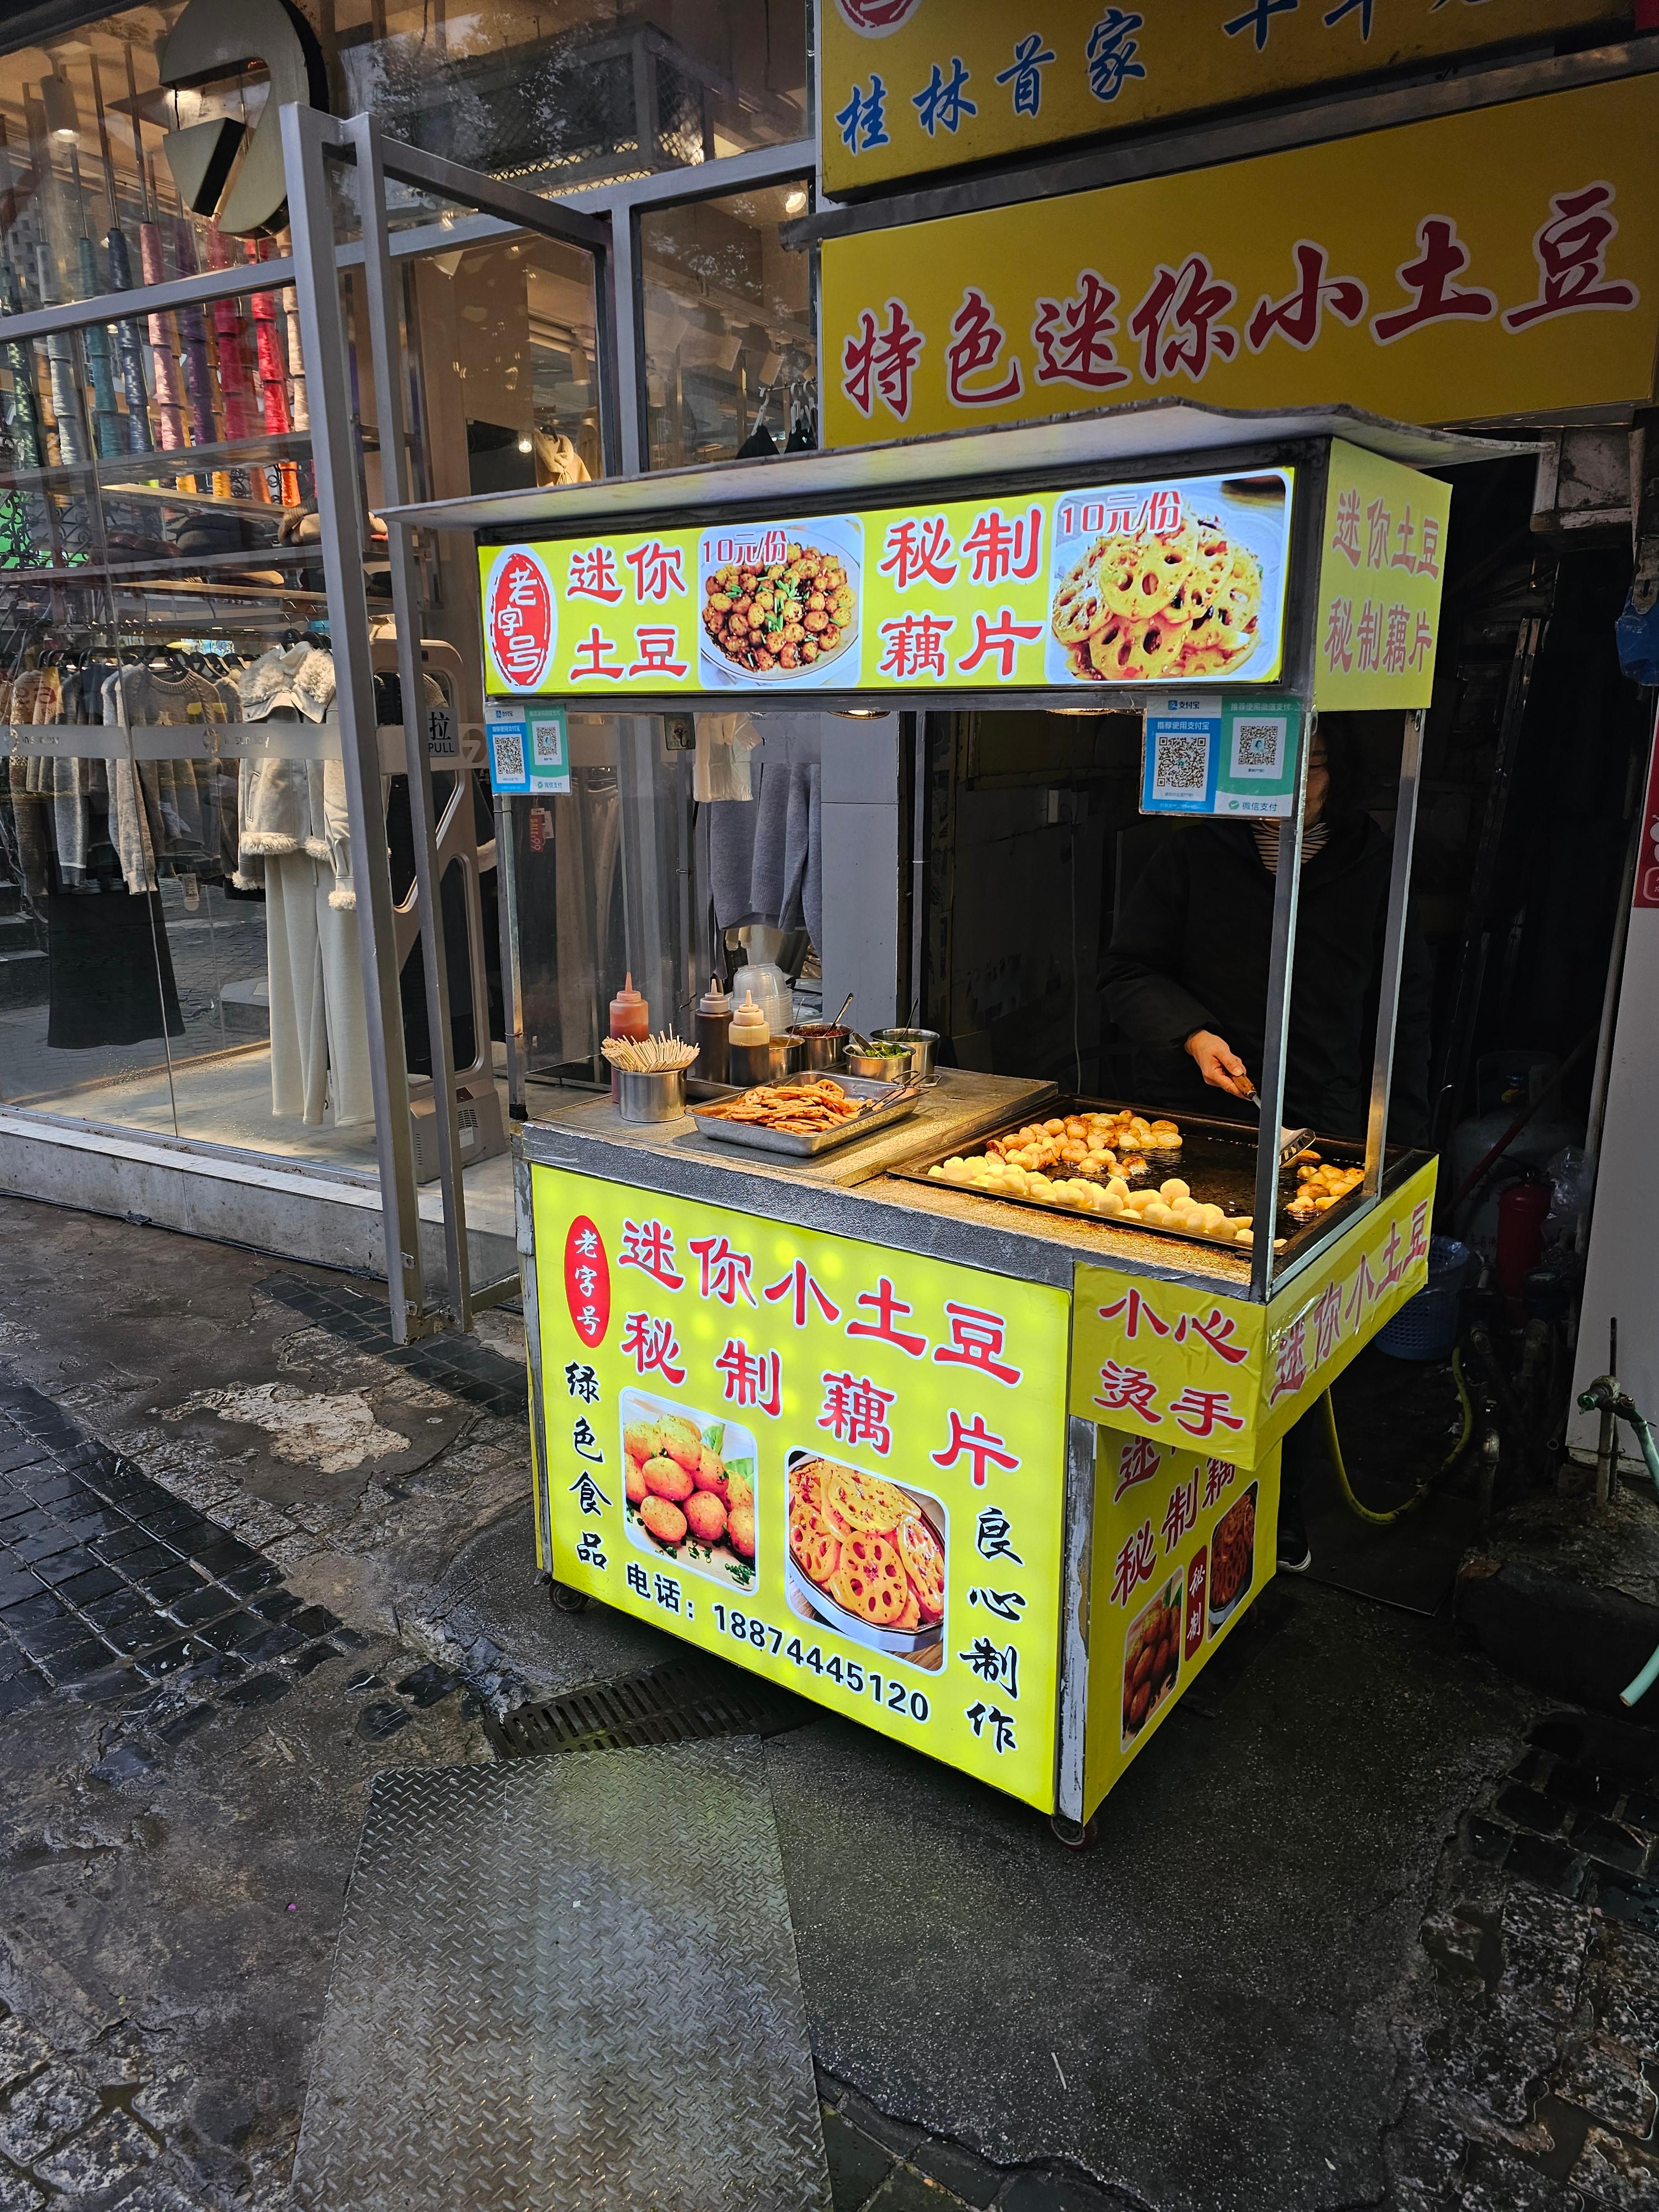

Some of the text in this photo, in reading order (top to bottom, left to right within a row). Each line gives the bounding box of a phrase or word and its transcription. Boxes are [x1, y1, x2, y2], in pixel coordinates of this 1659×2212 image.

[836, 8, 1146, 155] 桂林首家
[842, 184, 1635, 420] 特色迷你小土豆
[703, 530, 787, 565] 10元/份
[880, 508, 1041, 588] 秘制
[1062, 491, 1182, 533] 10元/份
[1332, 488, 1439, 580] 迷你土豆
[567, 542, 686, 602] 迷你
[498, 567, 542, 672] 老字号
[569, 628, 687, 680] 土豆
[880, 611, 1042, 677] 藕片
[1324, 597, 1433, 674] 秘制藕片
[428, 742, 455, 753] PULL
[429, 712, 452, 741] 拉
[1157, 721, 1209, 730] 推荐使用支付宝
[1242, 802, 1278, 811] 微信支付
[574, 1229, 601, 1335] 老字号
[619, 1220, 1021, 1385] 迷你小土豆
[1270, 1201, 1428, 1406] 迷你小土豆
[1098, 1288, 1248, 1364] 小心
[621, 1313, 1020, 1486] 秘制藕片
[1094, 1360, 1244, 1436] 烫手
[565, 1361, 612, 1570] 绿色食品
[959, 1507, 1026, 1754] 良心制作
[1186, 1564, 1206, 1641] 秘制
